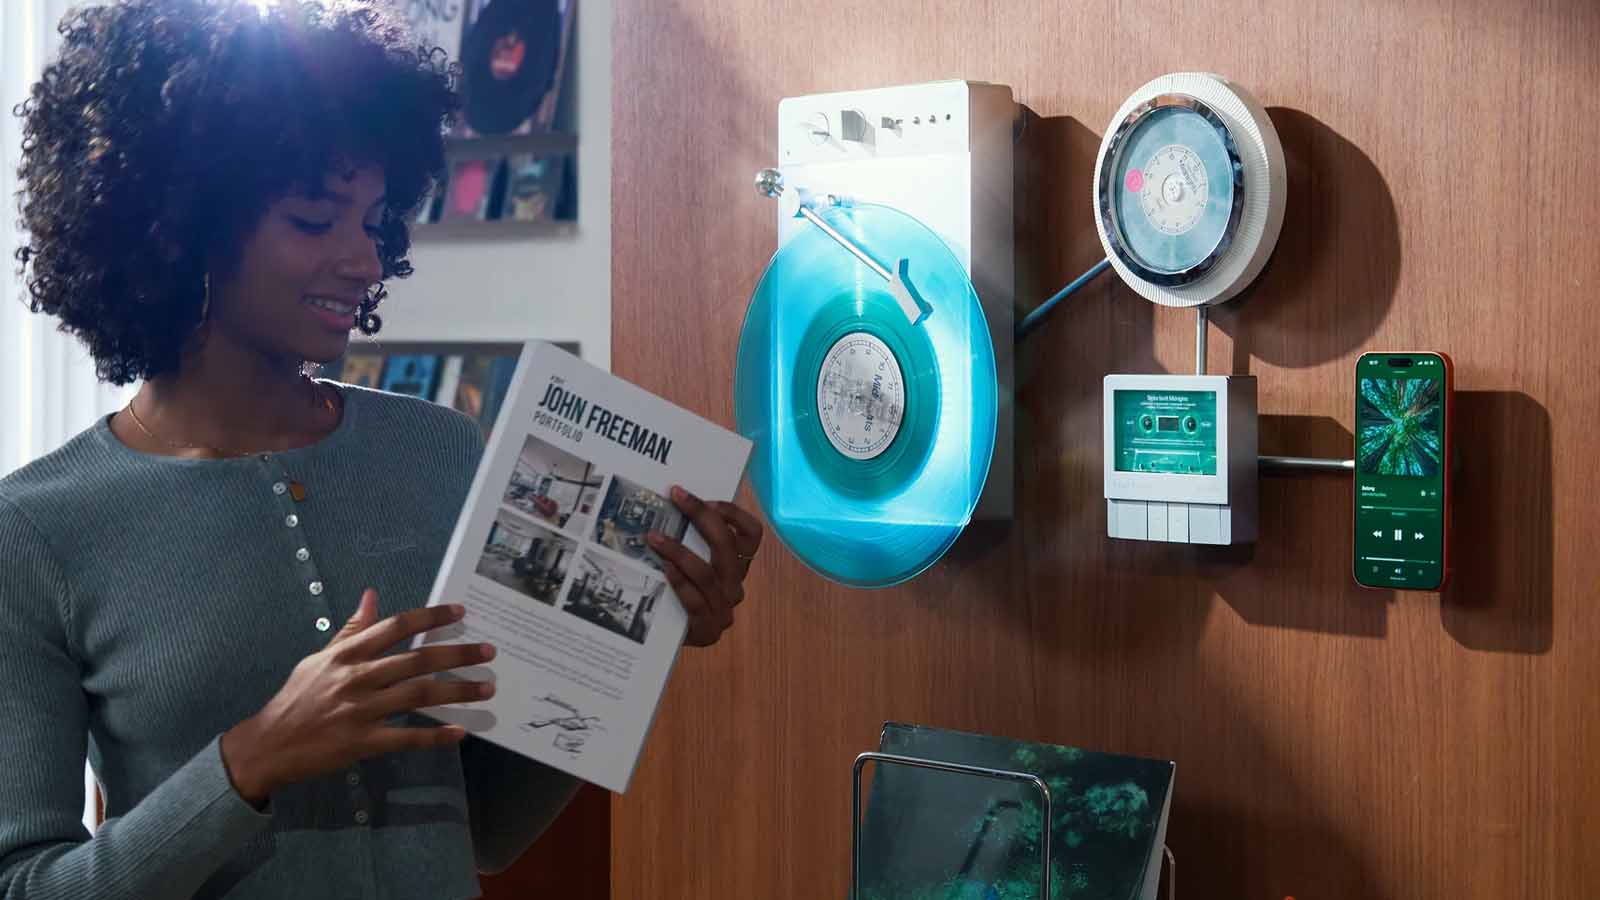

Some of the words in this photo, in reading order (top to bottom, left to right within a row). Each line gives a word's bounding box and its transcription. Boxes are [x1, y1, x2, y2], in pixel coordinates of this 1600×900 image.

[533, 410, 583, 442] PORTFOLIO
[538, 383, 588, 424] JOHN
[585, 403, 672, 464] FREEMAN
